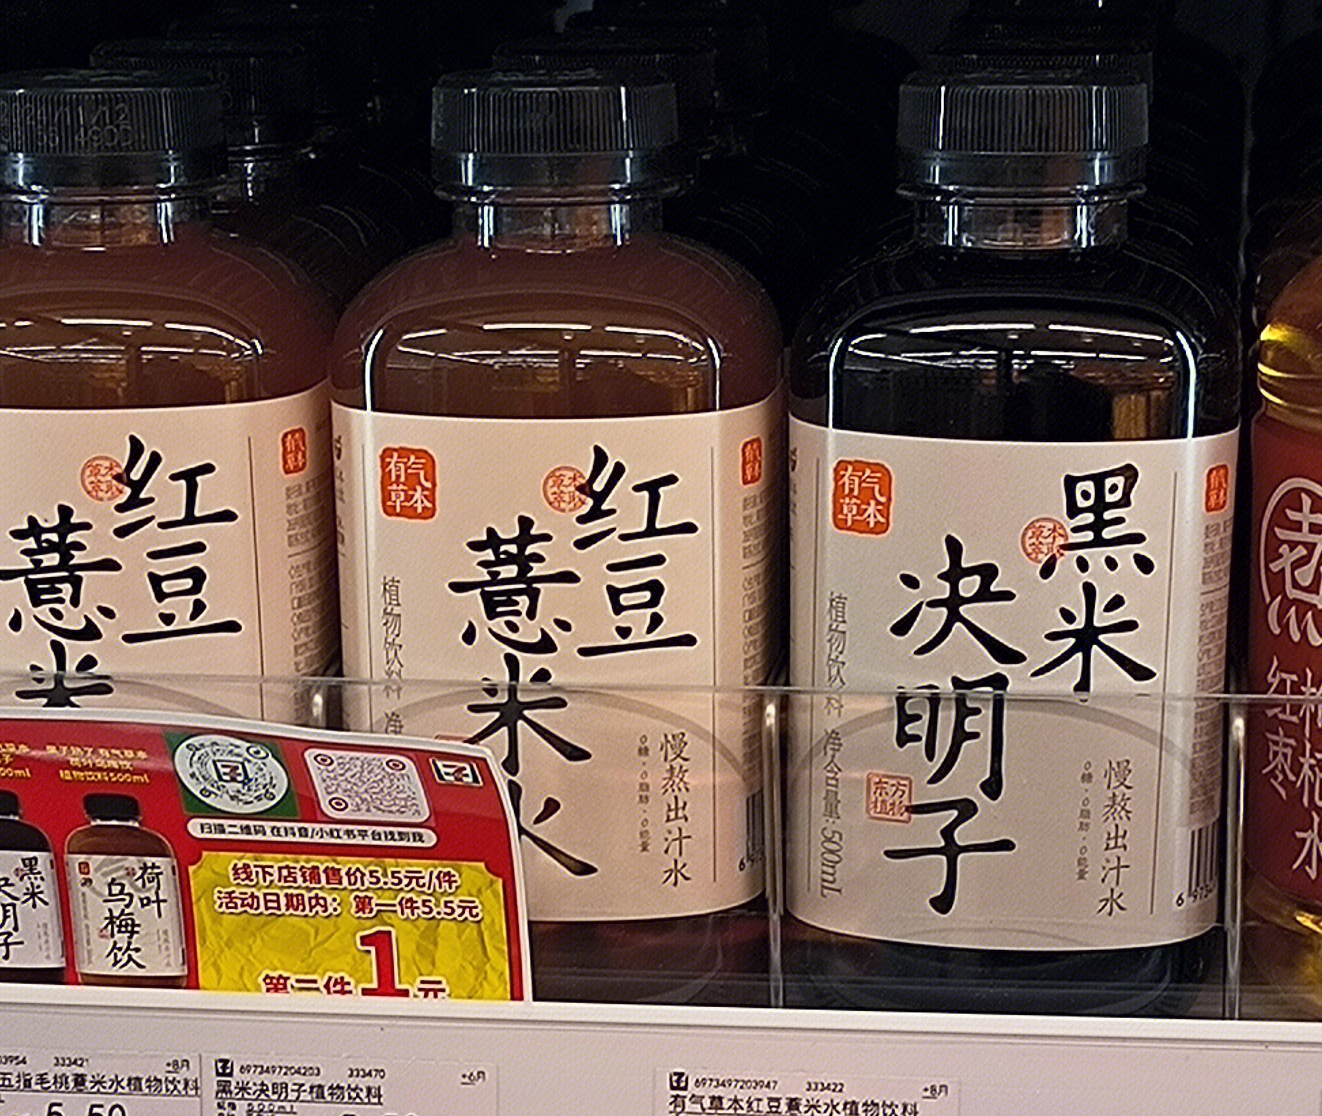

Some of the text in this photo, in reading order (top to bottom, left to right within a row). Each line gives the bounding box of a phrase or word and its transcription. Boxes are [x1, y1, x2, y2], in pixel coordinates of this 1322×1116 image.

[113, 434, 242, 644] 红豆
[573, 444, 698, 658] 红豆
[1030, 463, 1157, 704] 黑米
[448, 515, 598, 876] 薏米水
[883, 535, 1027, 915] 决明子
[1262, 657, 1300, 801] 红枣
[18, 855, 49, 910] 黑米
[199, 822, 266, 839] 扫描二维码
[231, 862, 459, 891] 线下店铺售价5.5元/件
[660, 731, 692, 887] 慢熬出汁水
[1097, 759, 1134, 916] 慢熬出汁水
[102, 877, 147, 971] 乌梅饮
[135, 861, 168, 919] 荷叶
[215, 1080, 383, 1103] 黑米决明子植物饮料
